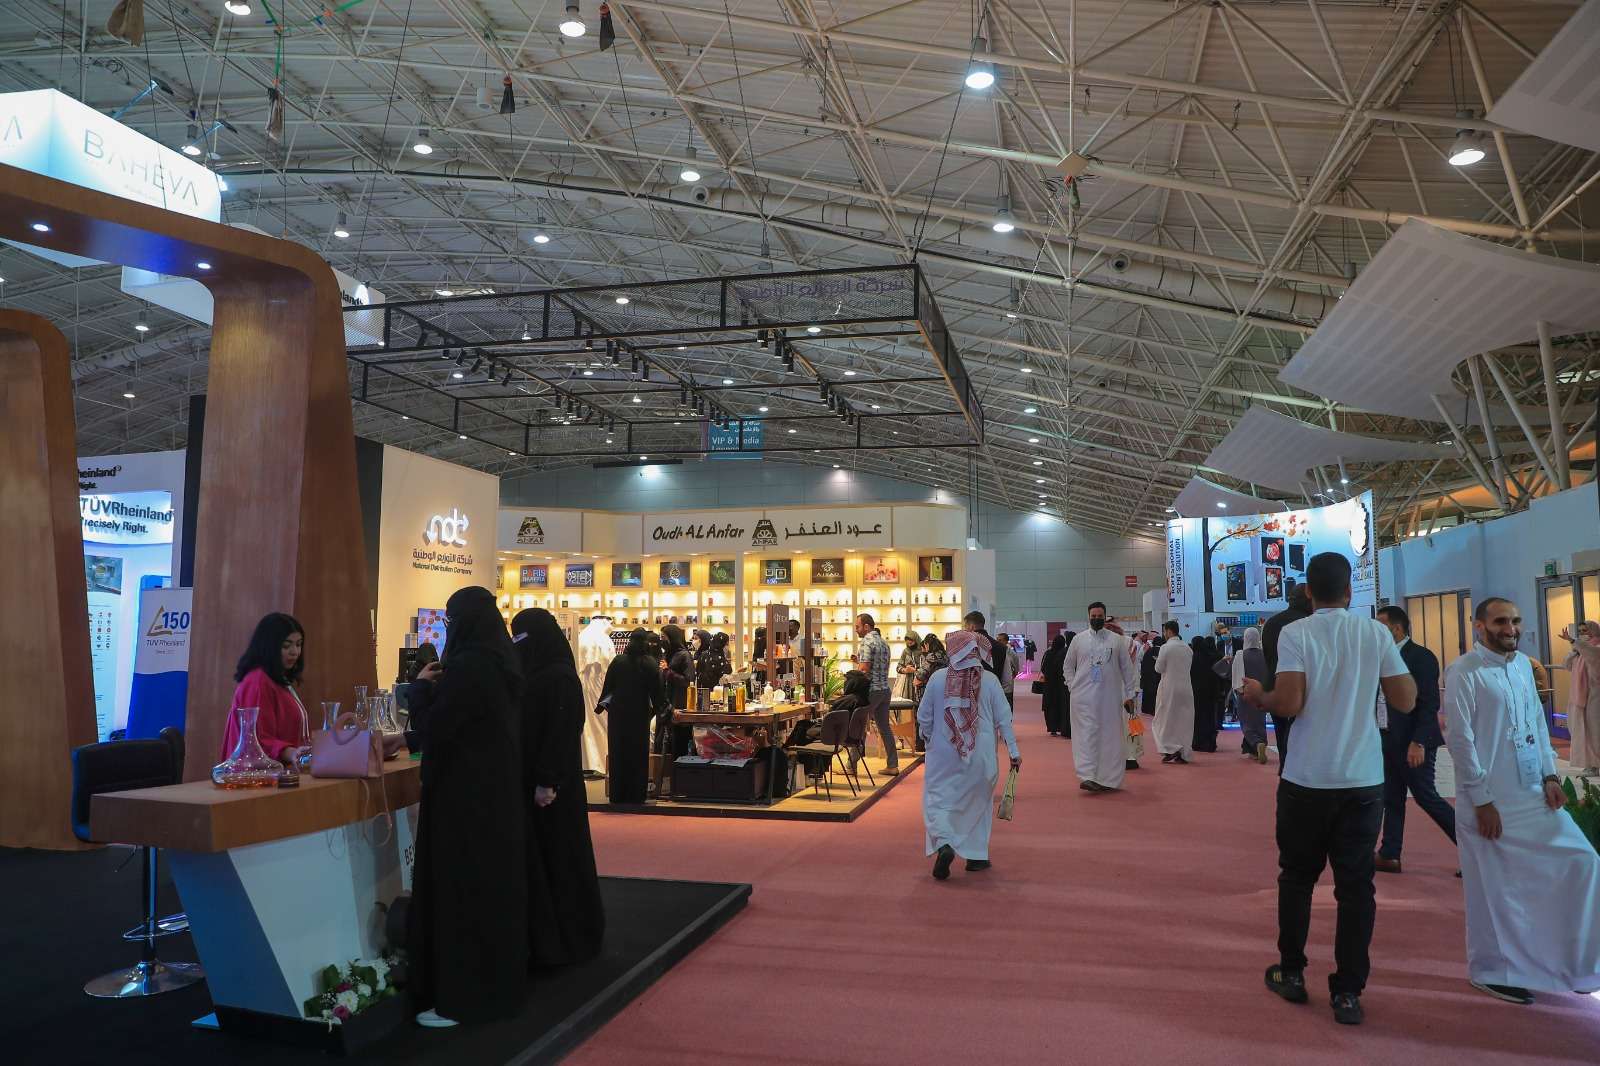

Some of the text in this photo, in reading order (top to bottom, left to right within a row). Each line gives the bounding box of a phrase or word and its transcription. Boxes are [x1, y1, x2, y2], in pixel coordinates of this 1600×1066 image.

[727, 436, 733, 444] &
[122, 521, 149, 533] Right.
[652, 526, 683, 541] Oudh
[705, 523, 745, 539] Anfar
[784, 520, 882, 541] عود العنفر
[522, 569, 546, 577] PARIS
[162, 611, 190, 629] 150
